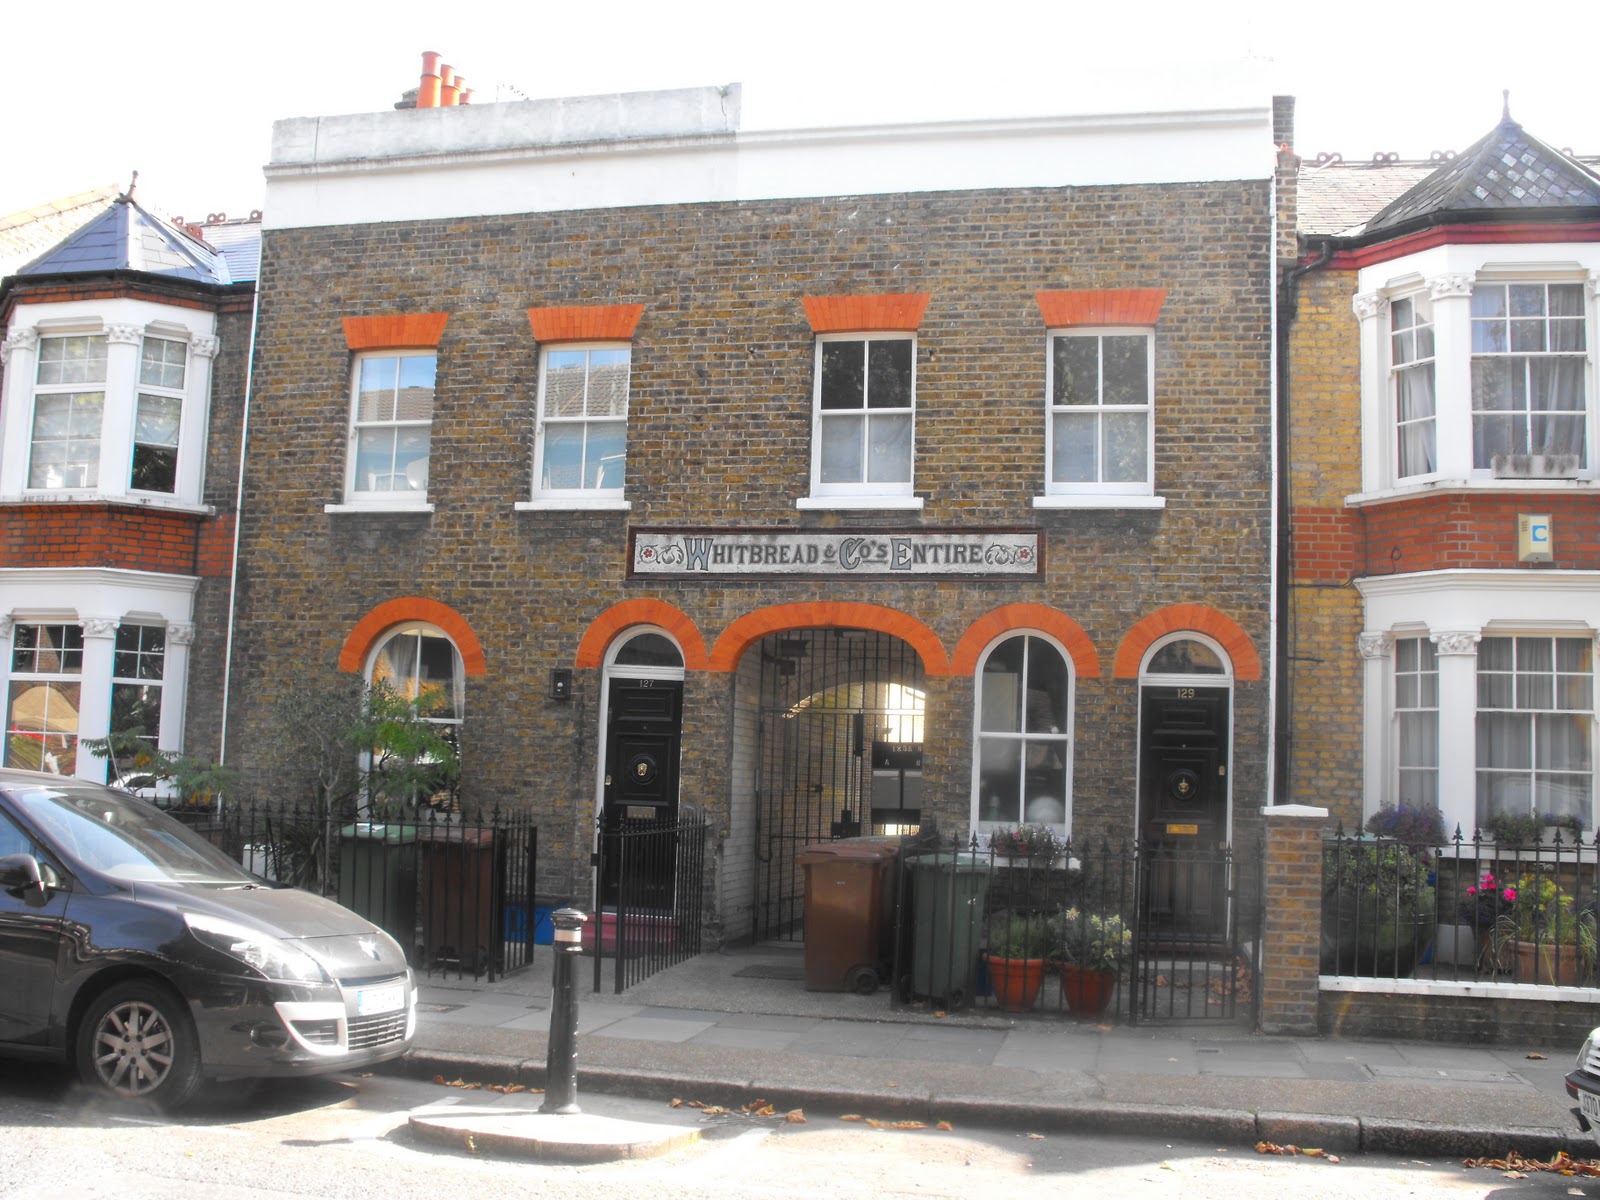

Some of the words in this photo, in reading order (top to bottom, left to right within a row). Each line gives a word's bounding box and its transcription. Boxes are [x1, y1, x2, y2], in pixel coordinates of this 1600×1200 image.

[683, 537, 819, 571] WHITBREAD
[823, 544, 837, 561] &
[839, 538, 888, 571] CO'S
[890, 537, 983, 571] ENTIRE
[640, 679, 655, 688] 127
[1176, 688, 1195, 699] 129
